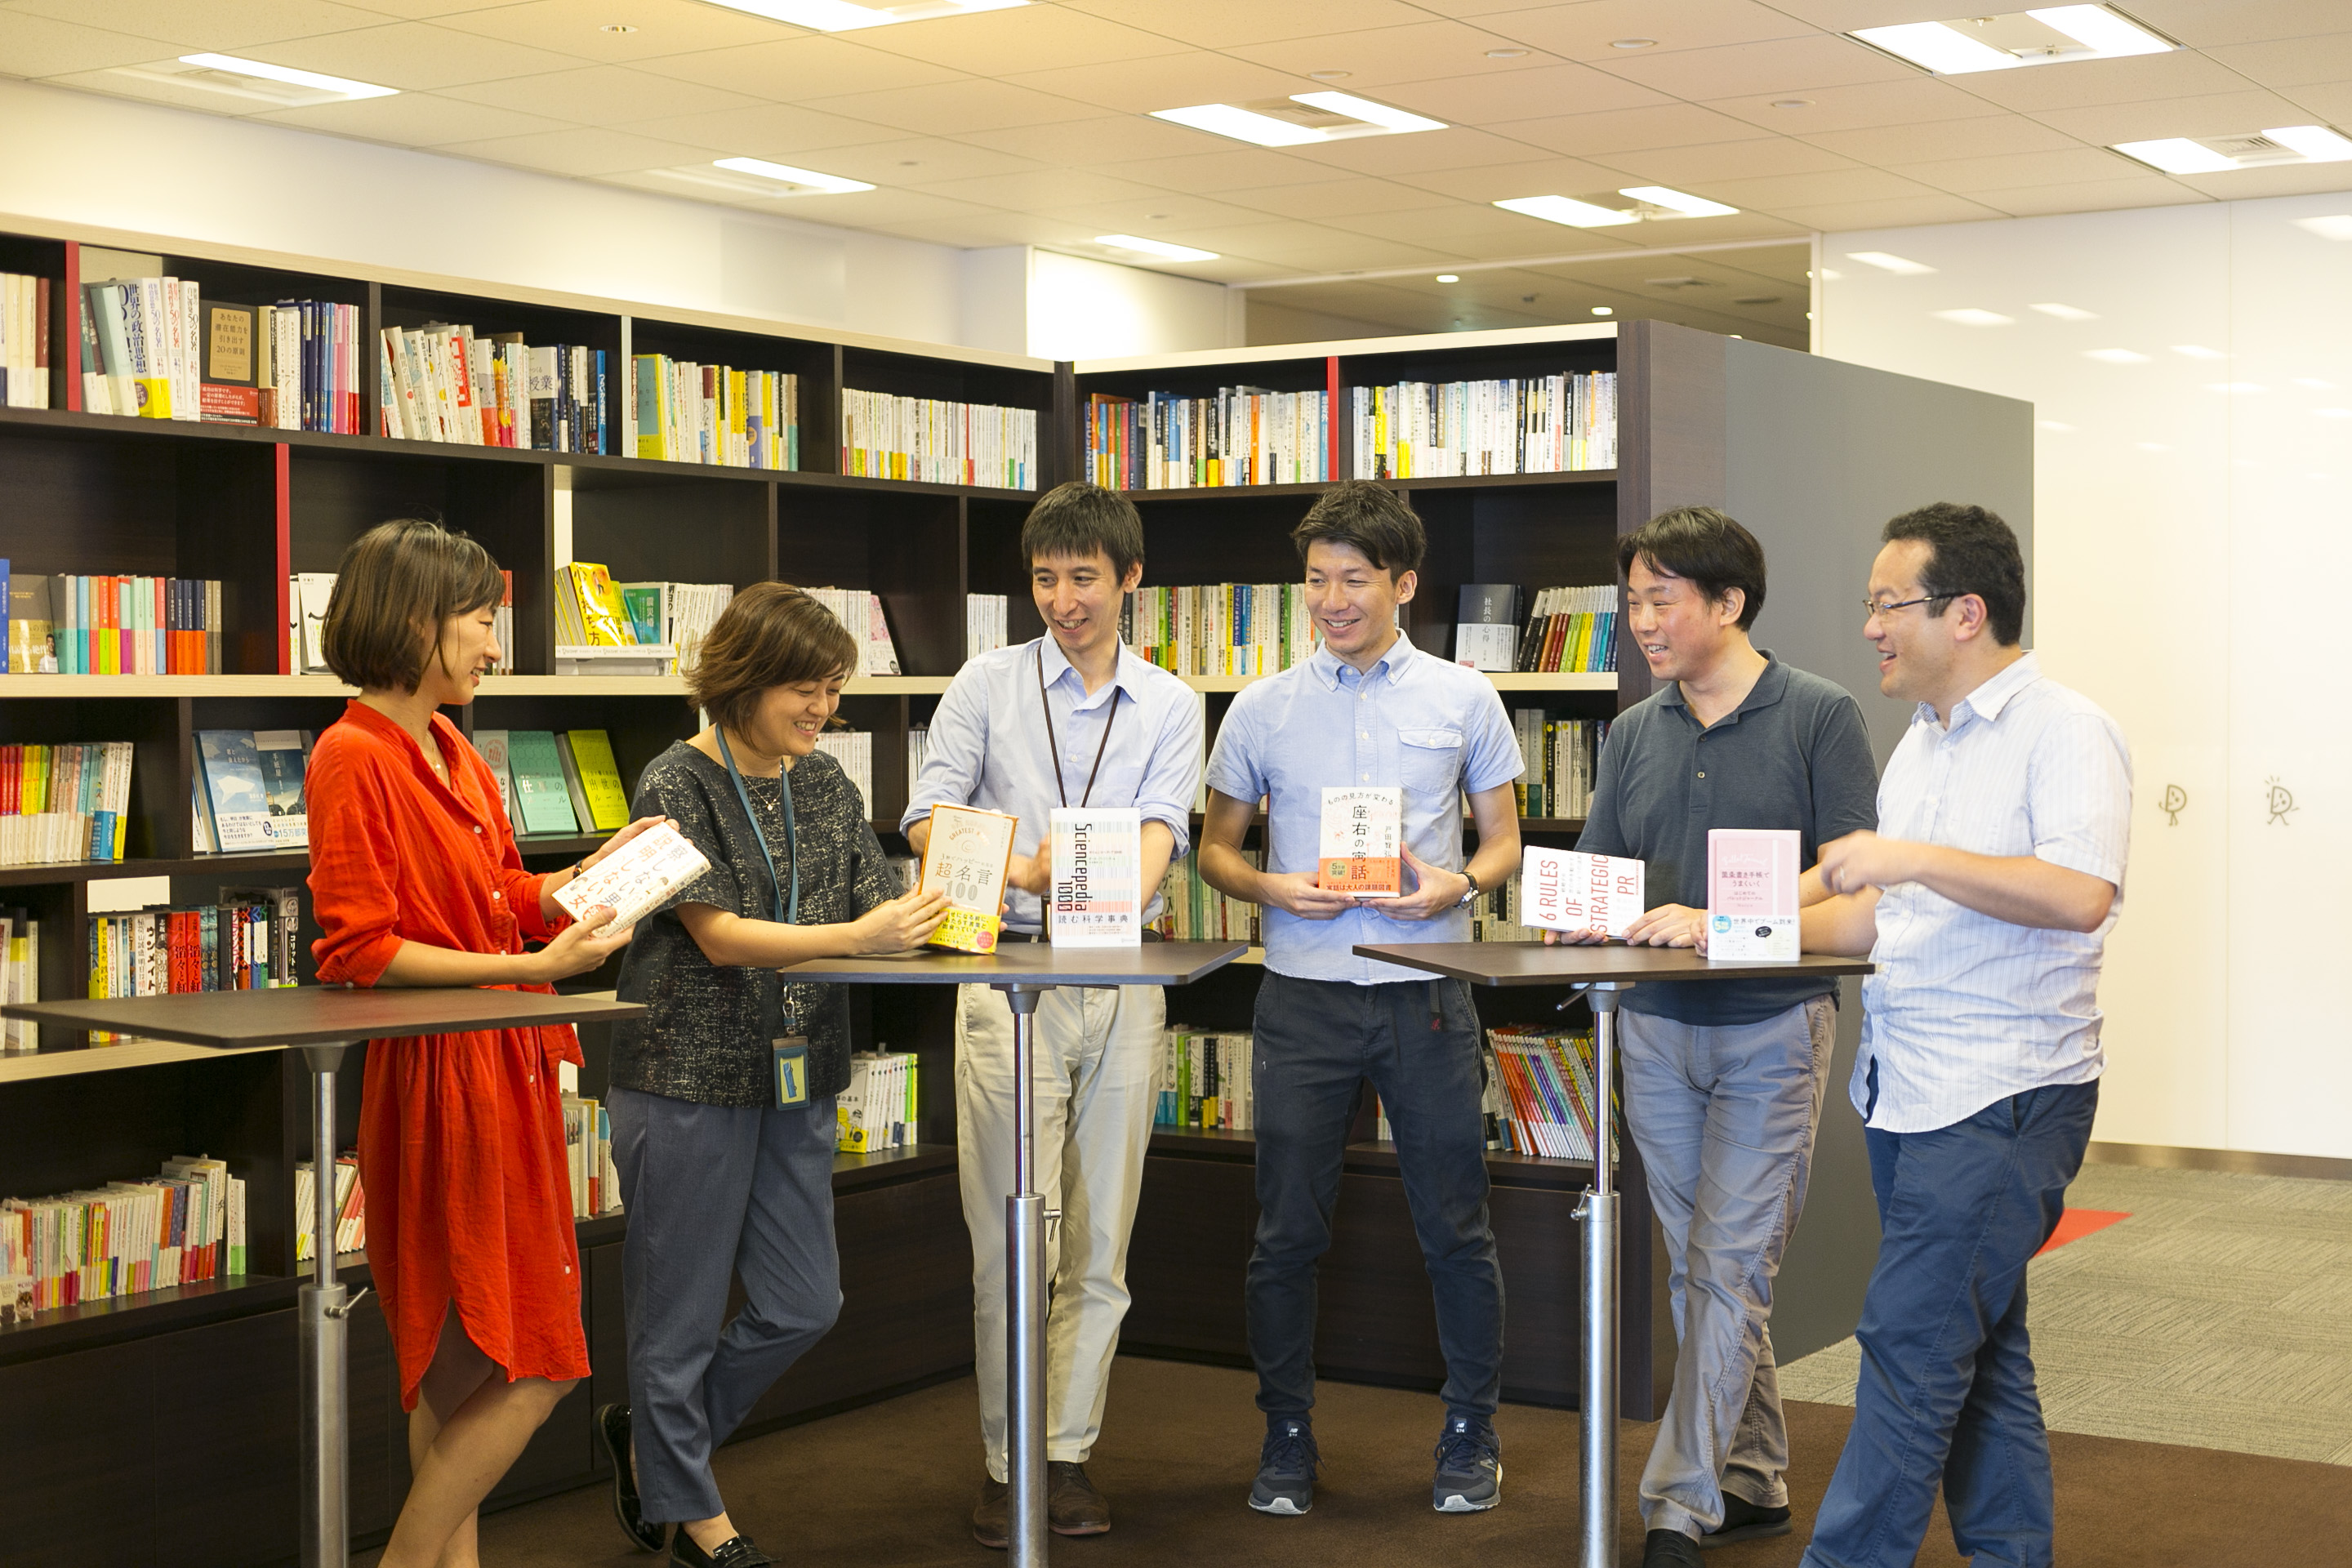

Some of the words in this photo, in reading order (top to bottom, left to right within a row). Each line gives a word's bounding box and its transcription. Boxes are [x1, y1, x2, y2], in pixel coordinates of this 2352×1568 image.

[220, 313, 244, 322] あなたの
[129, 283, 146, 373] 世界の政治思想
[216, 345, 245, 355] 20の原則
[219, 336, 243, 344] 引き出す
[1482, 596, 1493, 643] 社長の心得
[595, 793, 623, 802] ルール
[1328, 792, 1393, 805] ものの見方が変わる
[1351, 804, 1368, 880] 座右の寓話
[569, 834, 674, 910] 説明しない女
[935, 862, 993, 886] 超名言
[1071, 823, 1093, 911] Sciencepedia
[945, 880, 978, 901] 100
[1539, 860, 1558, 907] RULES
[1590, 854, 1609, 933] STRATEGIC
[1617, 875, 1635, 895] PR
[1732, 880, 1761, 888] うまくいく
[1058, 881, 1073, 911] 1000
[1539, 912, 1557, 921] 6
[1566, 897, 1583, 916] OF
[1058, 915, 1129, 924] 読む科学事典
